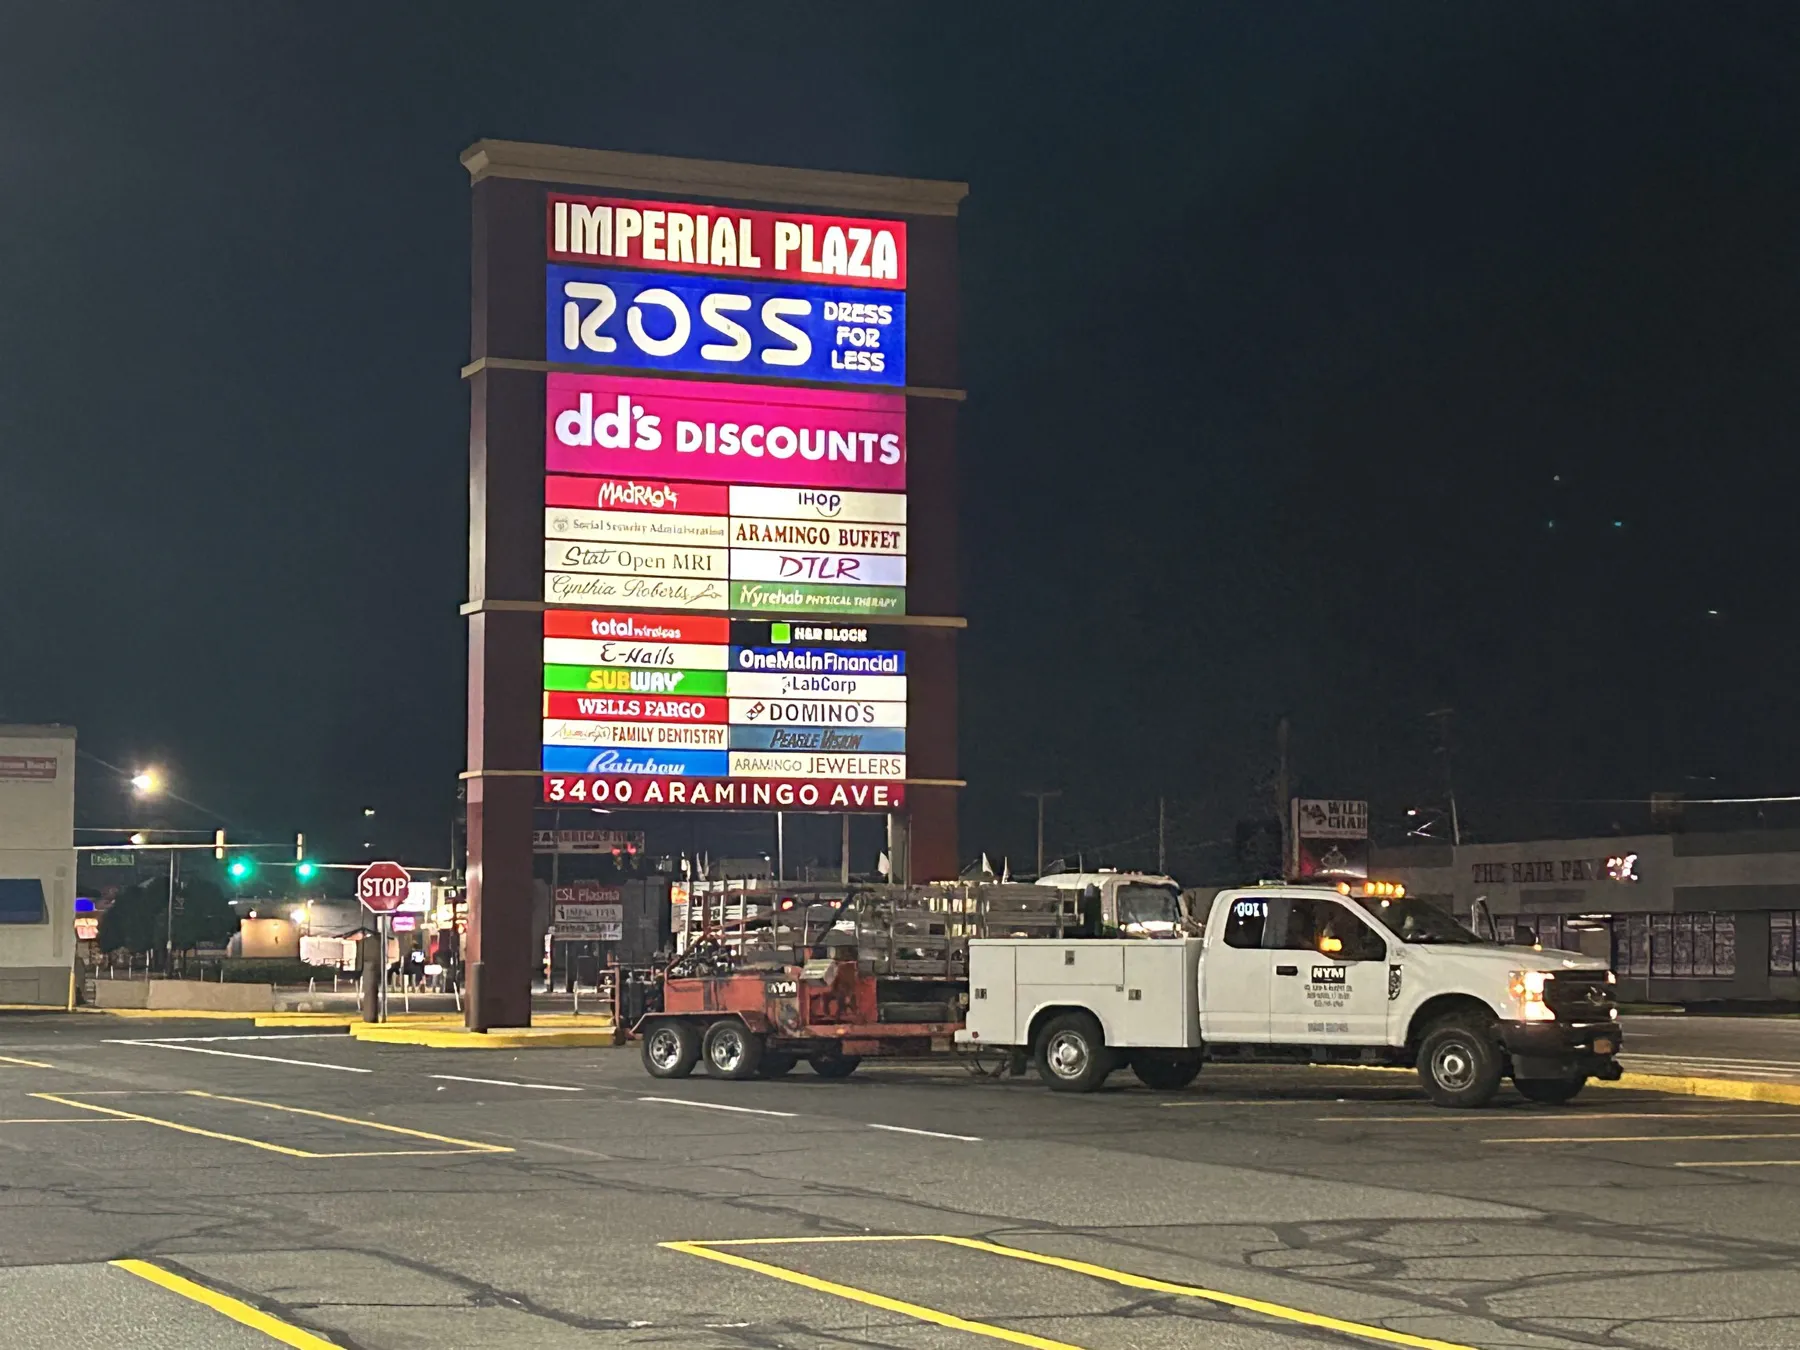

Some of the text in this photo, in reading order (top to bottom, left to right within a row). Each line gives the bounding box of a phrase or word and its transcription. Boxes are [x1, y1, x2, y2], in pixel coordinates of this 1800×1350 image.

[554, 202, 898, 280] IMPERIAL PLAZA
[564, 281, 813, 367] ROSS
[824, 301, 892, 325] DRESS
[835, 326, 880, 349] FOR
[831, 350, 885, 372] LESS
[555, 392, 901, 465] dd's DISCOUNTS
[573, 519, 604, 531] Social
[736, 523, 901, 549] ARAMINGO BUFFET
[562, 546, 712, 571] Stat Open MRI
[779, 555, 861, 581] DTLR
[552, 575, 617, 600] Cynthia
[805, 595, 851, 606] PHYSICAL
[854, 596, 898, 608] THERAPY
[591, 618, 633, 636] total
[824, 629, 867, 642] BLOCK
[600, 642, 675, 665] E-Nails
[587, 670, 685, 692] SUBWAY
[793, 676, 857, 694] LabCorp
[577, 698, 705, 718] WELLS FARGO
[770, 702, 875, 723] DOMINO'S
[613, 726, 654, 742] FAMILY
[658, 728, 724, 744] DENTISTRY
[586, 750, 685, 775] Rainbow
[735, 757, 901, 774] ARAMINGO JEWELERS
[550, 779, 899, 806] 3400 ARAMINGO AVE.
[362, 877, 407, 898] STOP
[578, 888, 620, 902] Plasma
[1313, 967, 1344, 978] NYM
